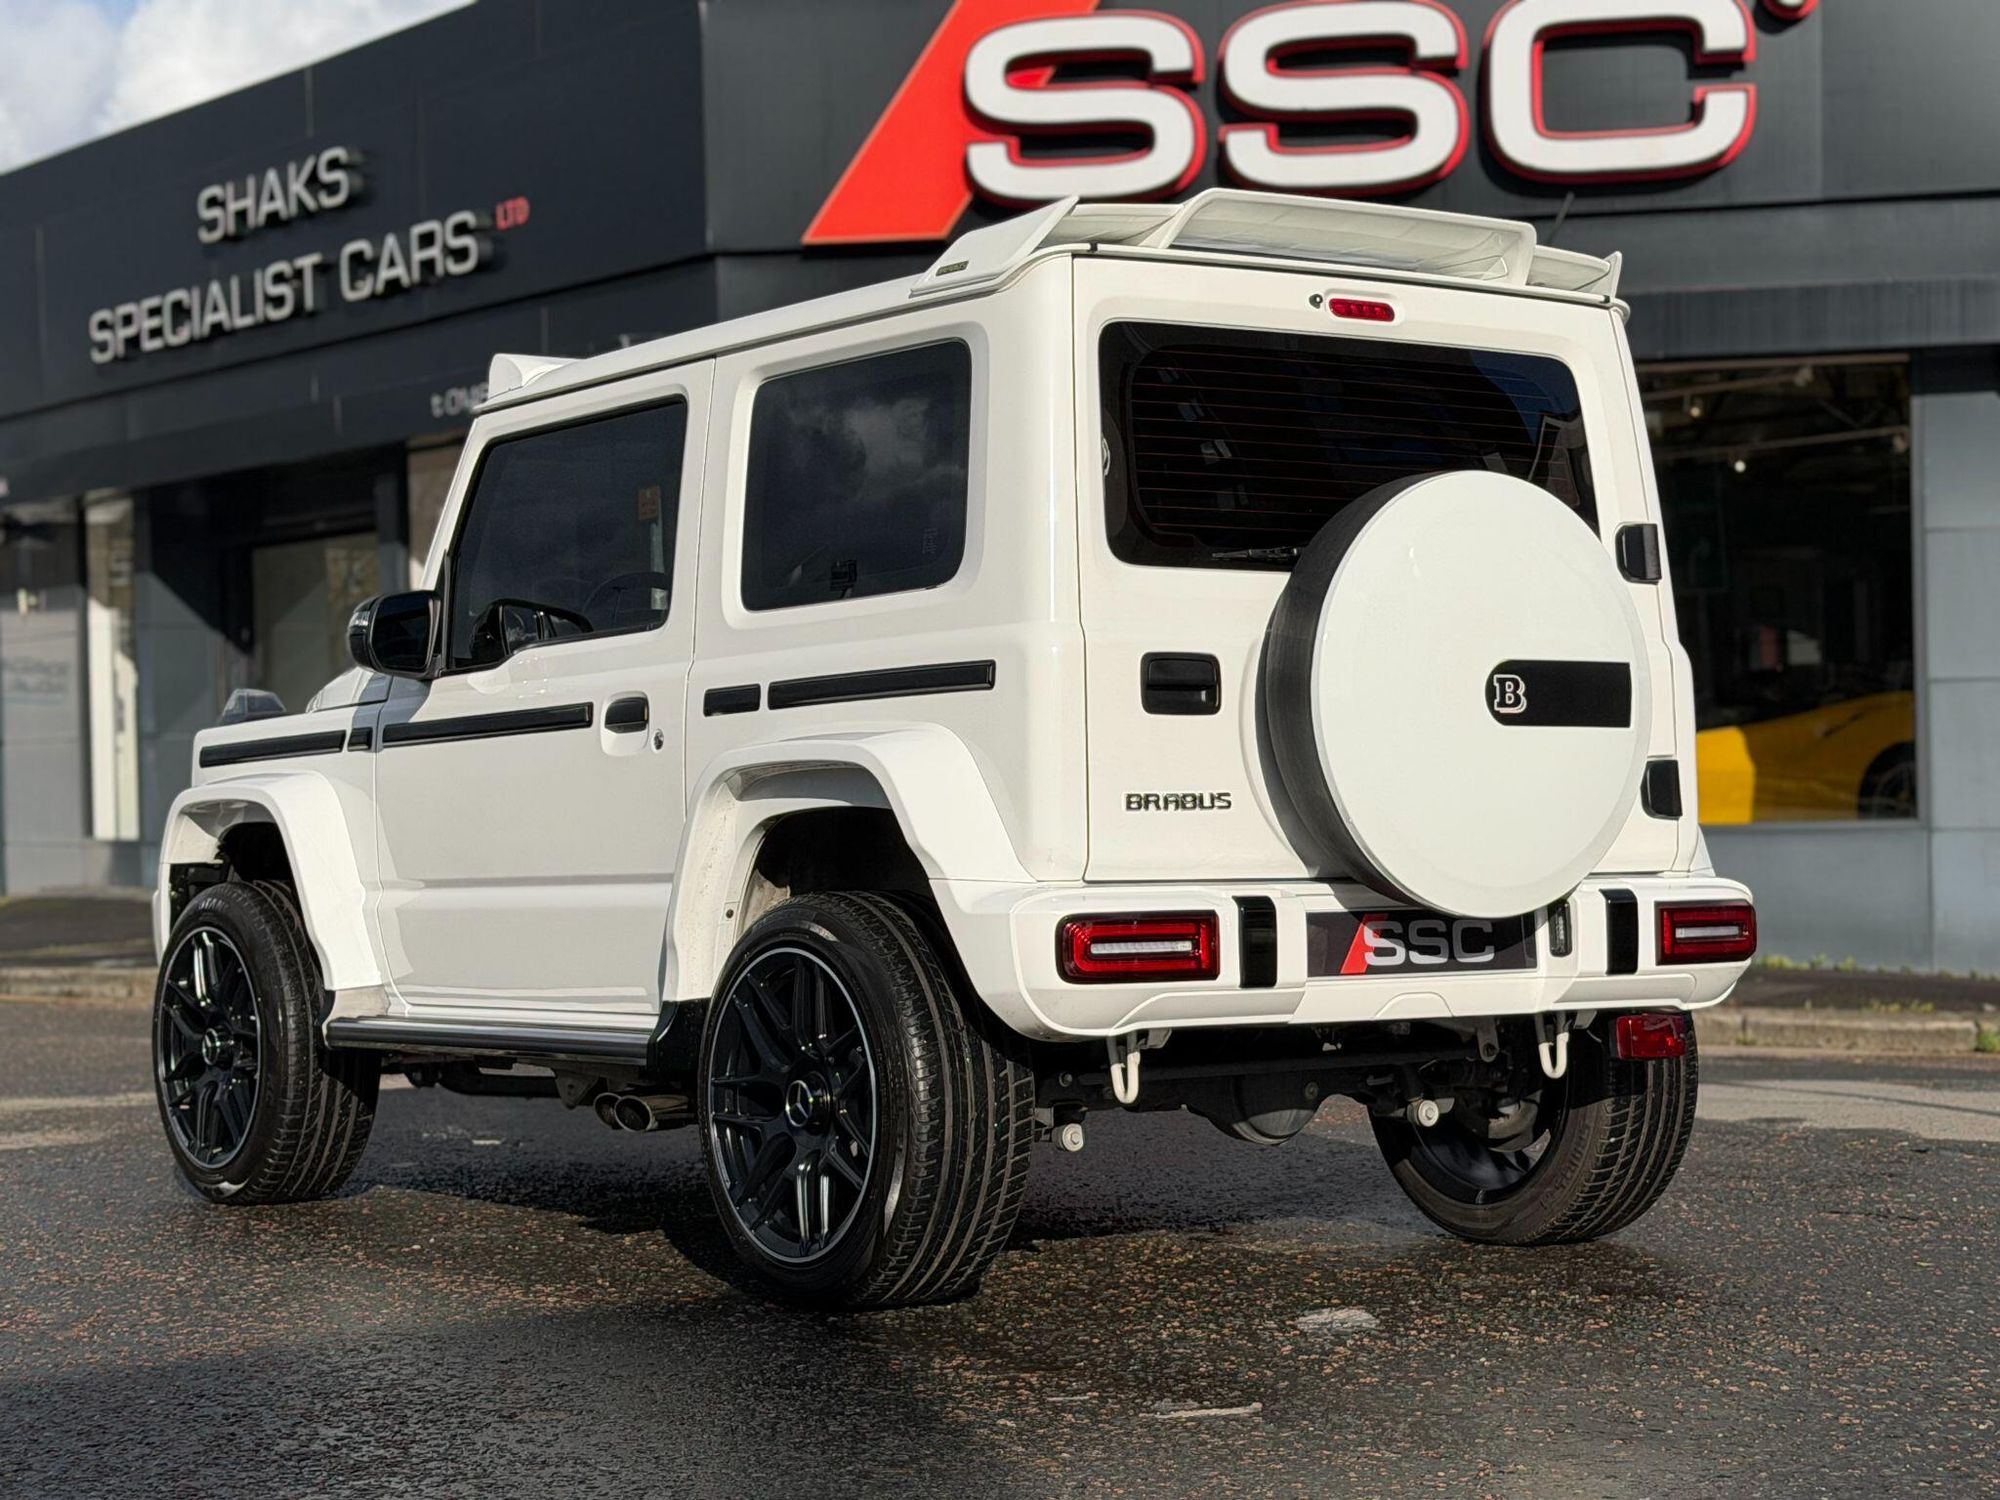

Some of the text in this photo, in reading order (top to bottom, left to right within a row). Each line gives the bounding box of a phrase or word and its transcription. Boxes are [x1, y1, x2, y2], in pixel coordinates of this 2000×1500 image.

[964, 0, 1757, 202] SSC
[197, 146, 351, 244] SHAKS
[89, 197, 530, 364] SPECIALIST CARS LTD
[1493, 673, 1527, 713] B
[1125, 791, 1232, 812] BRABUS
[1363, 919, 1496, 965] SSC
